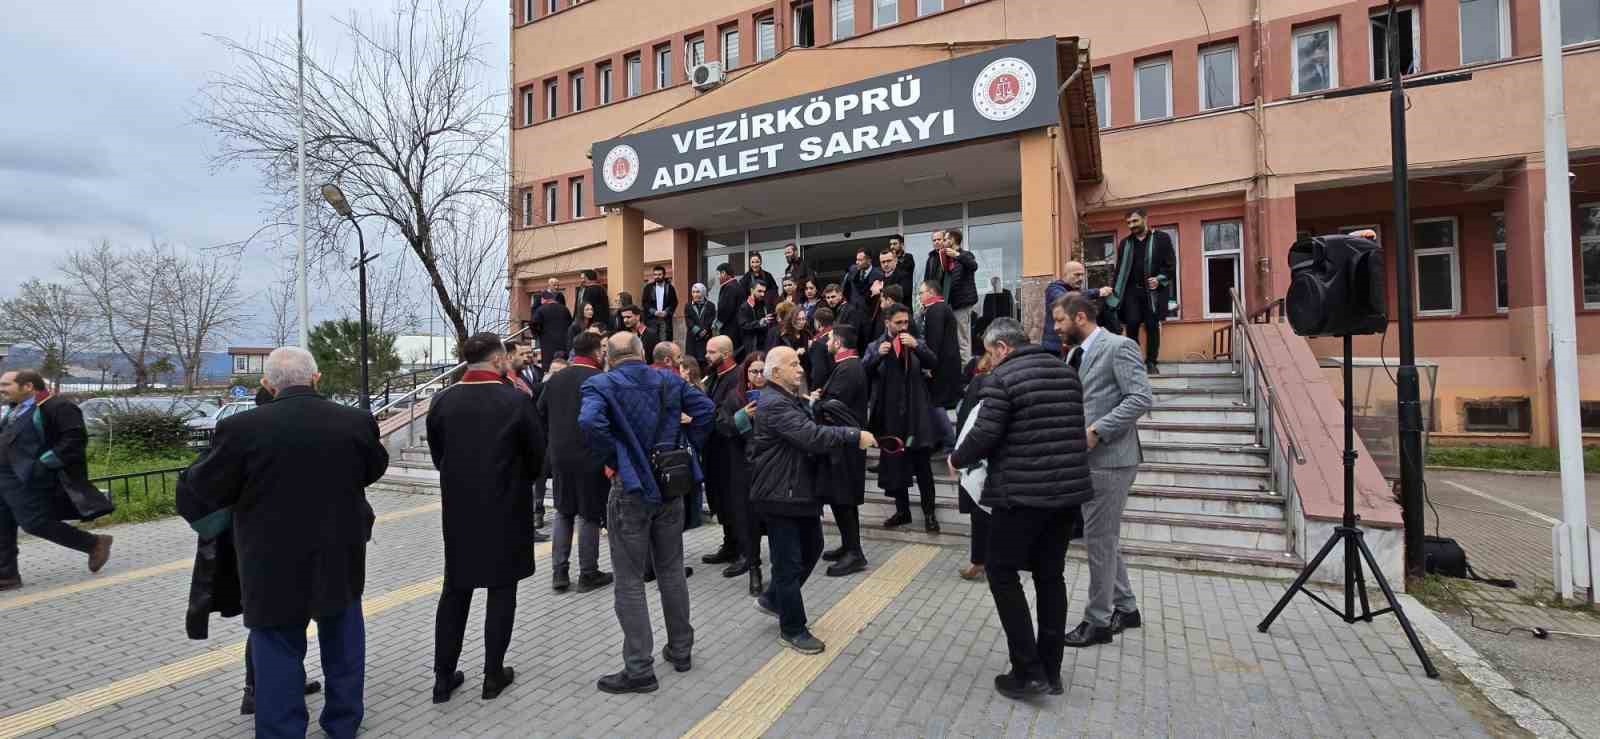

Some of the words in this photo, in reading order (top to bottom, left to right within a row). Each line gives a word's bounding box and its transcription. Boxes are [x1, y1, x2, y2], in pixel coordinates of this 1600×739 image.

[651, 143, 784, 190] ADALET
[799, 108, 955, 162] SARAYI
[671, 75, 921, 154] VEZİRKÖPRÜ
